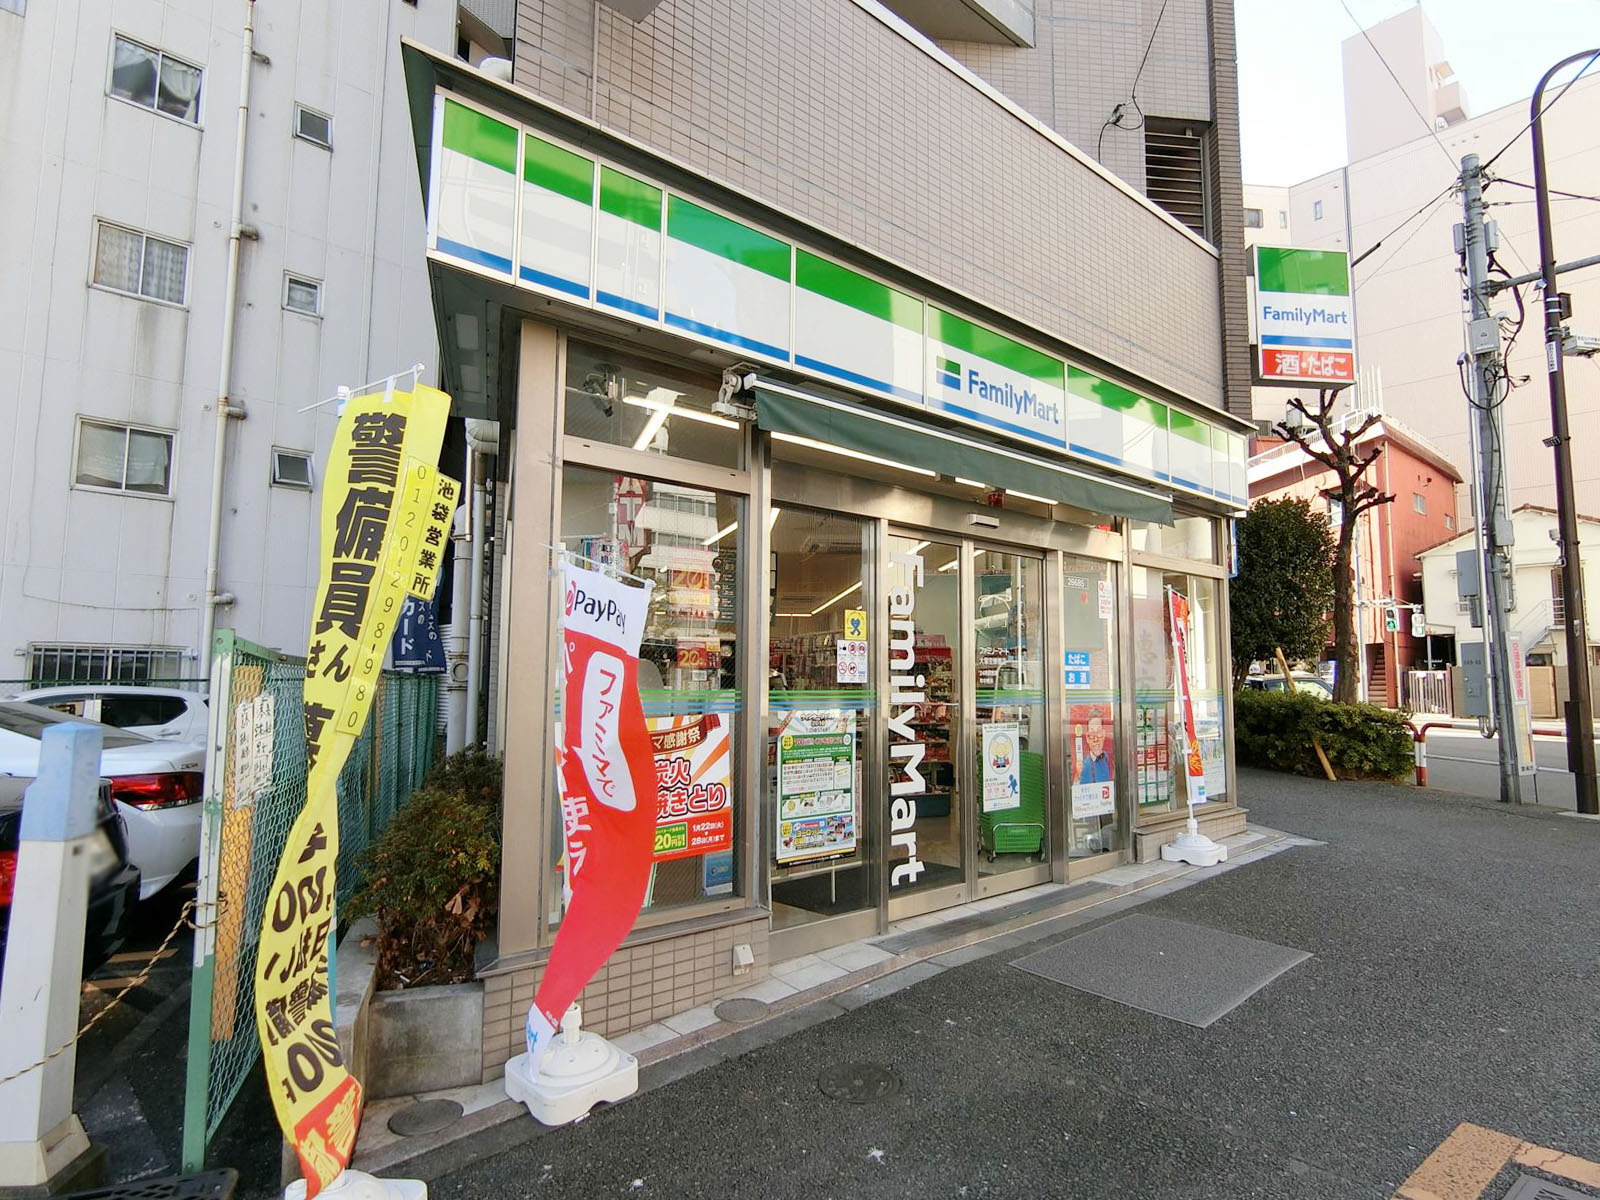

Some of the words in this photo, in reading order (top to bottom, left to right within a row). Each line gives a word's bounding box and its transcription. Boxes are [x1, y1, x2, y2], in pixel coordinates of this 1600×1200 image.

[1263, 306, 1348, 325] FamilyMart
[968, 369, 1059, 424] FamilyMart
[412, 479, 454, 595] 池袋営業所
[574, 589, 626, 634] PayPay
[592, 669, 617, 797] ファミマで
[888, 552, 925, 887] FamilyMart
